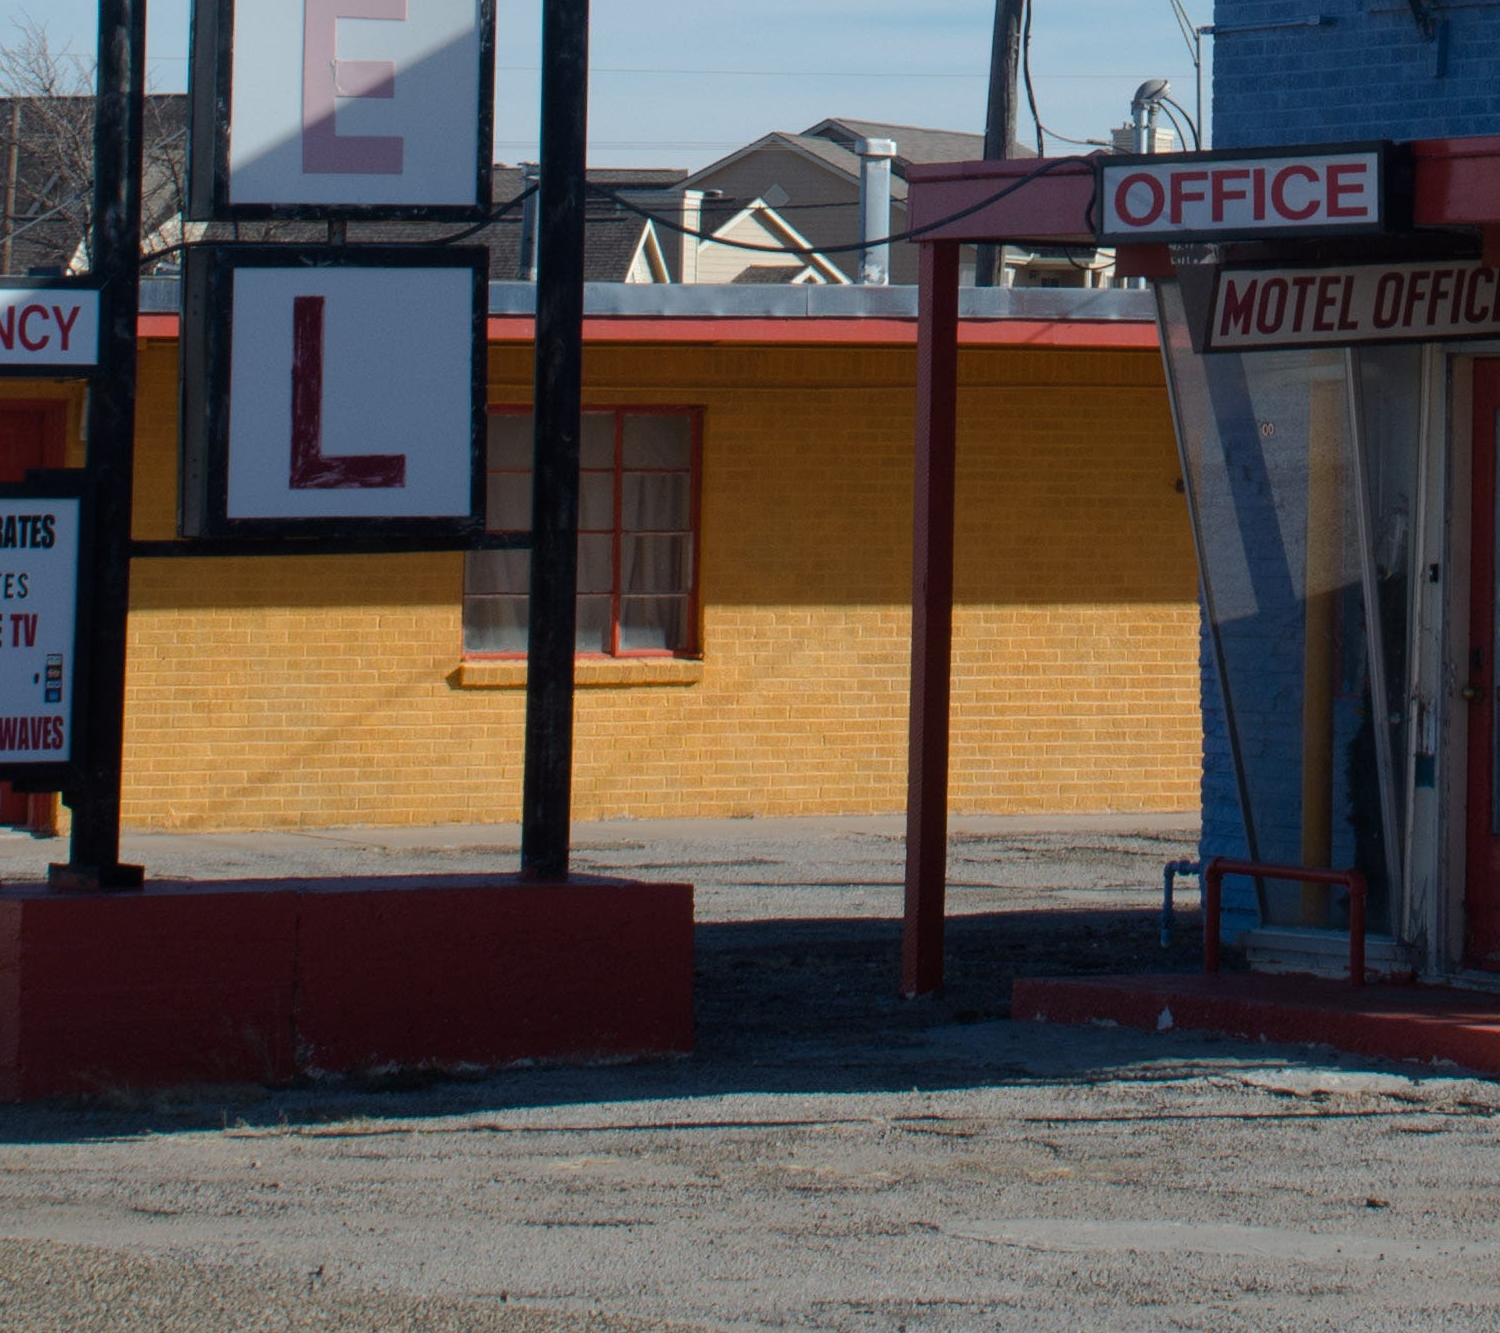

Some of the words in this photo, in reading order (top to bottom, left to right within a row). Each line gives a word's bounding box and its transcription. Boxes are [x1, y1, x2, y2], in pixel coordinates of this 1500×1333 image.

[1114, 162, 1369, 227] OFFICE
[1219, 275, 1358, 336] MOTEL
[9, 613, 38, 647] TV
